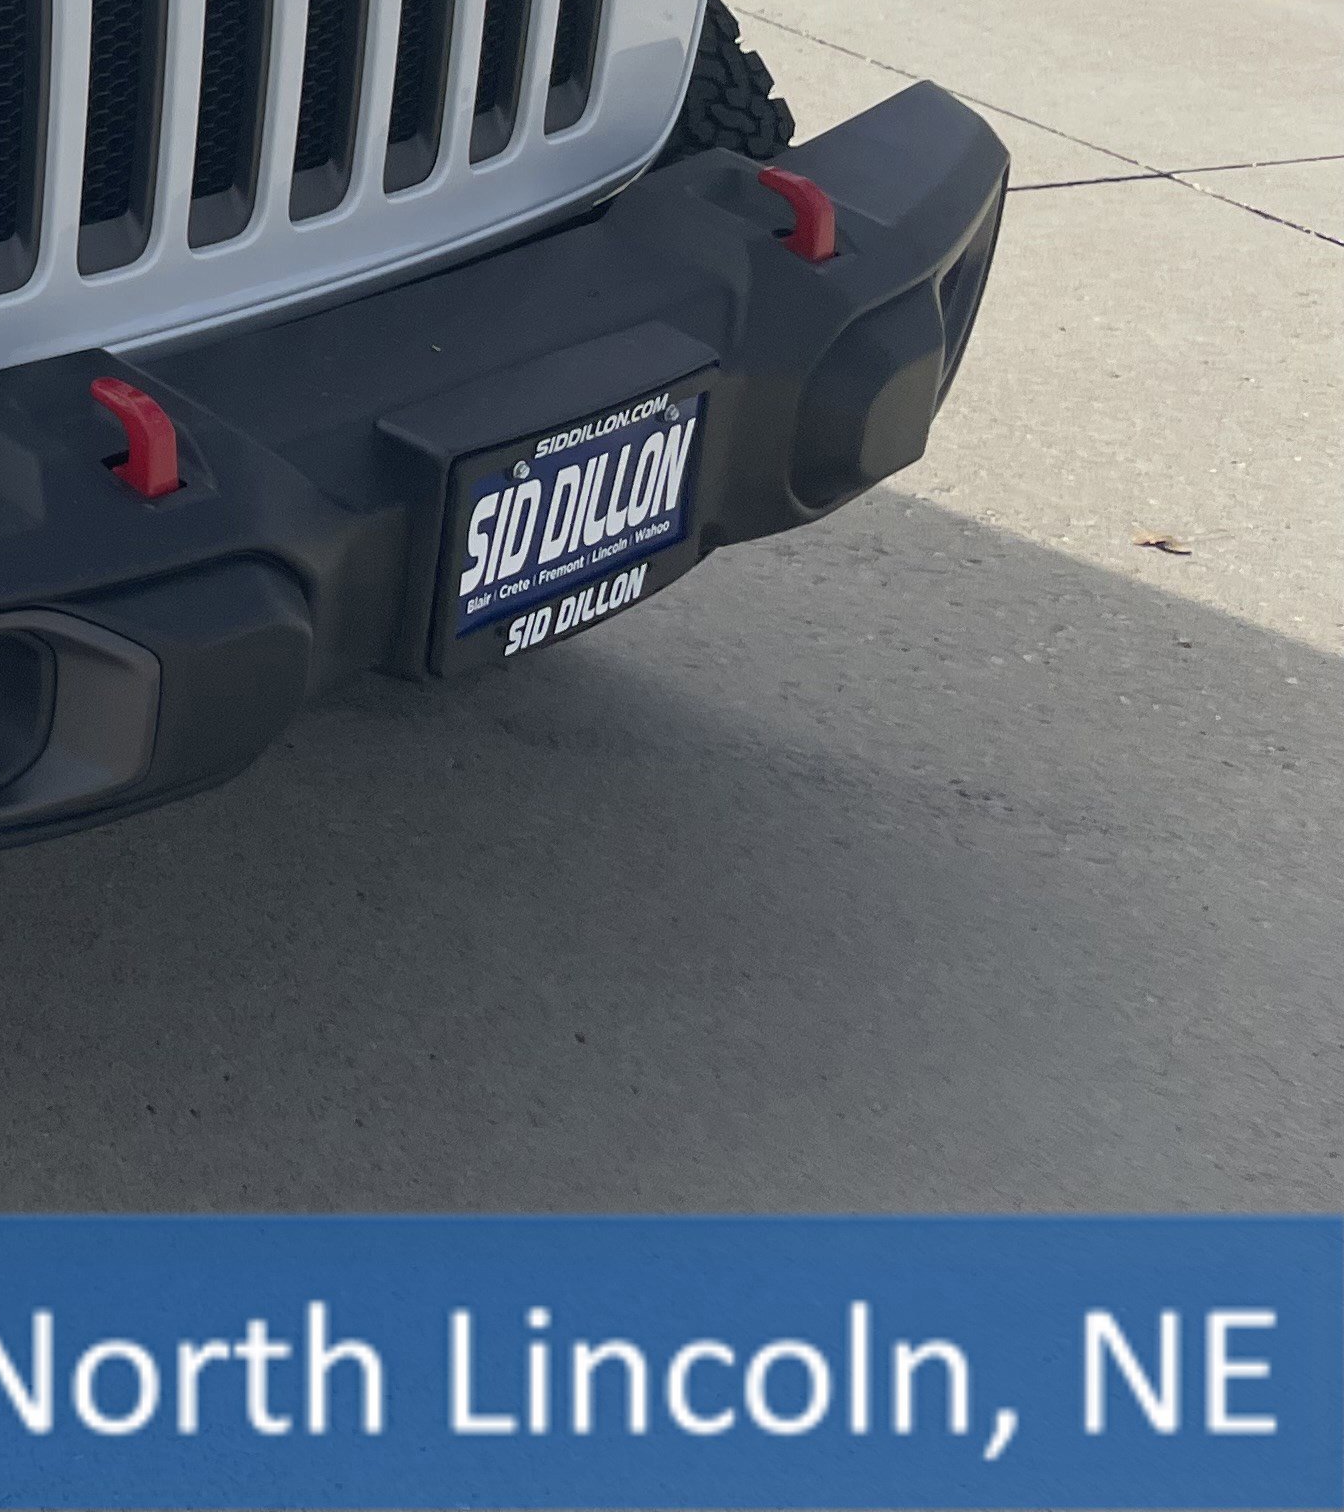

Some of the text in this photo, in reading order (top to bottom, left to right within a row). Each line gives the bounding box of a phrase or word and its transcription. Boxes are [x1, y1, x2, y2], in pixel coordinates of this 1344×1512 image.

[535, 393, 669, 459] SIDDILLON.COM
[460, 417, 696, 596] SID DILLON
[467, 521, 670, 614] Blair Crete Fremont Lincoln Wahoo
[505, 563, 649, 656] SID DILLON
